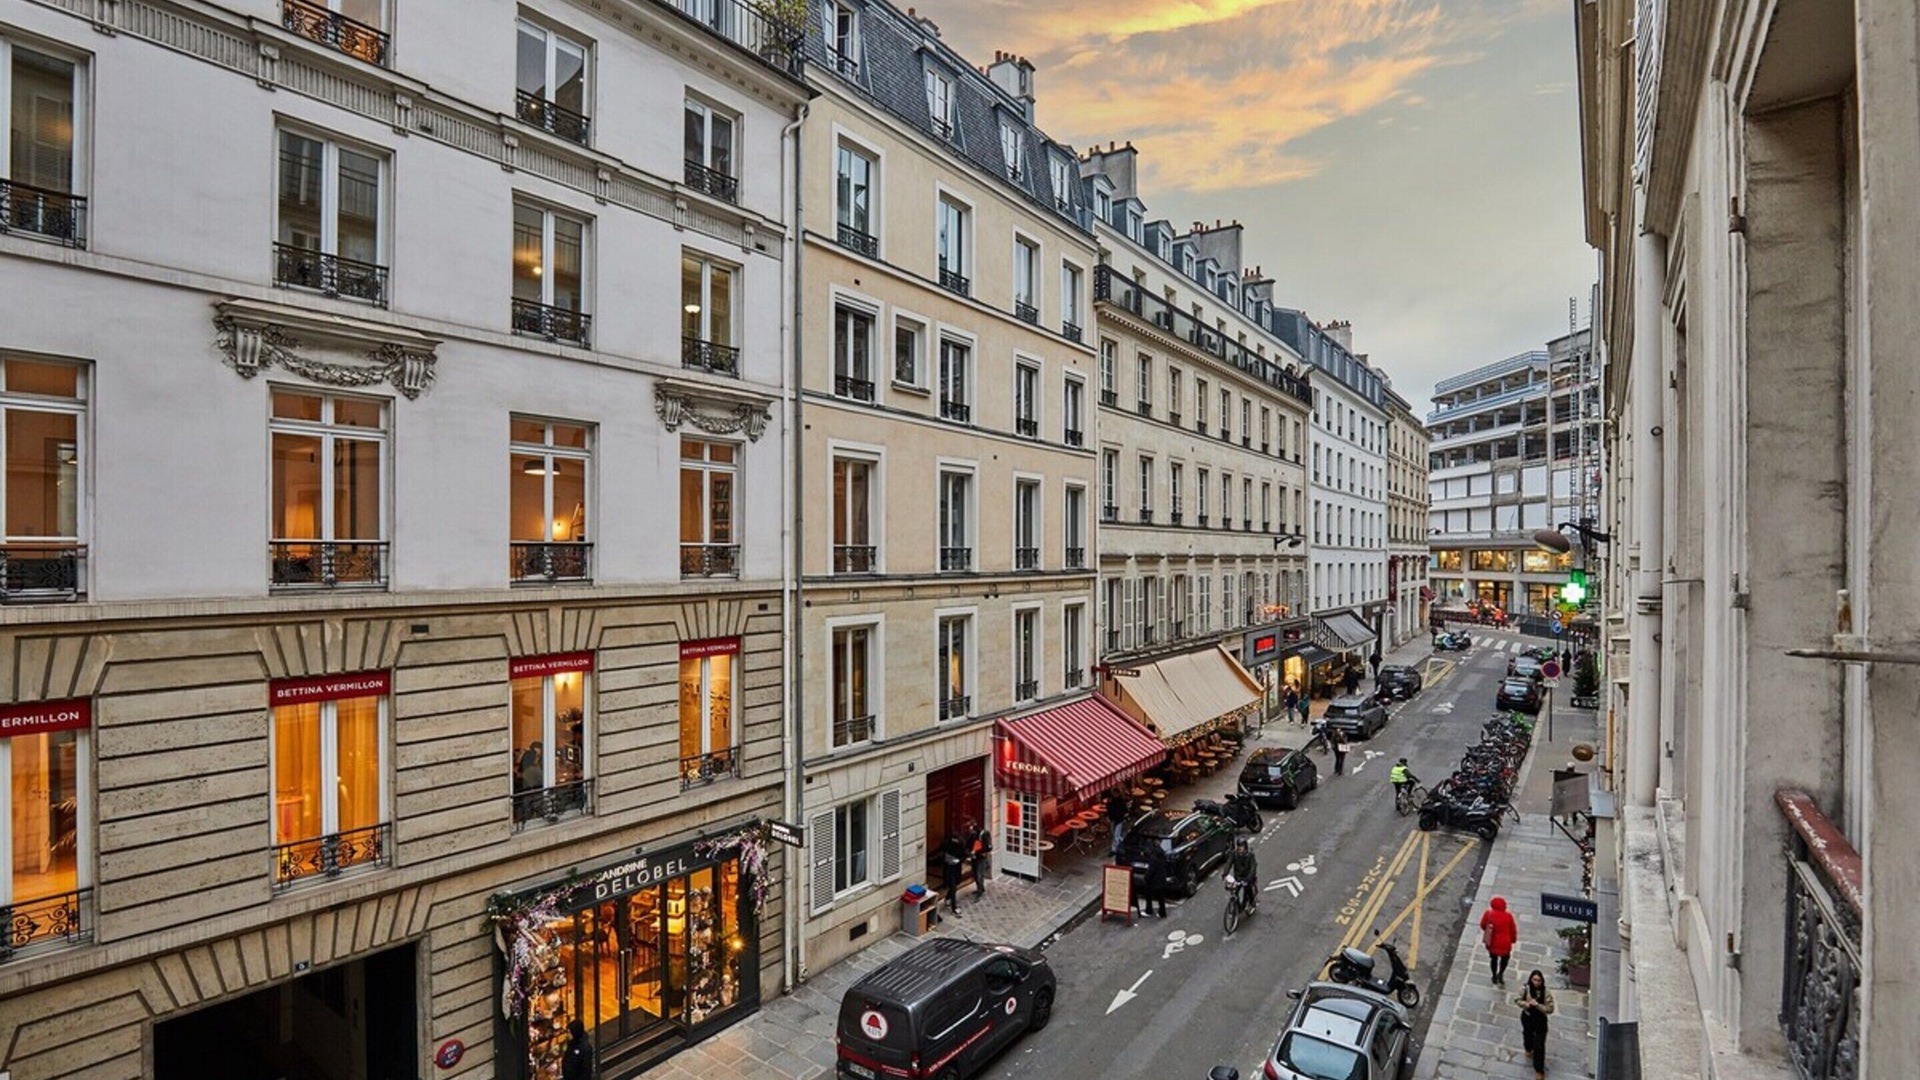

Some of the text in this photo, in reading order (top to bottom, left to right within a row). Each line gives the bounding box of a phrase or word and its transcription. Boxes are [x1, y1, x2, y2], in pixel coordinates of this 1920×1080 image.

[513, 659, 589, 673] BETTINA VERMILLON
[277, 680, 383, 698] BETTINA VERMILLON
[2, 711, 80, 728] ERMILLON
[596, 858, 687, 899] DELOBEL
[1544, 902, 1593, 917] BREUER
